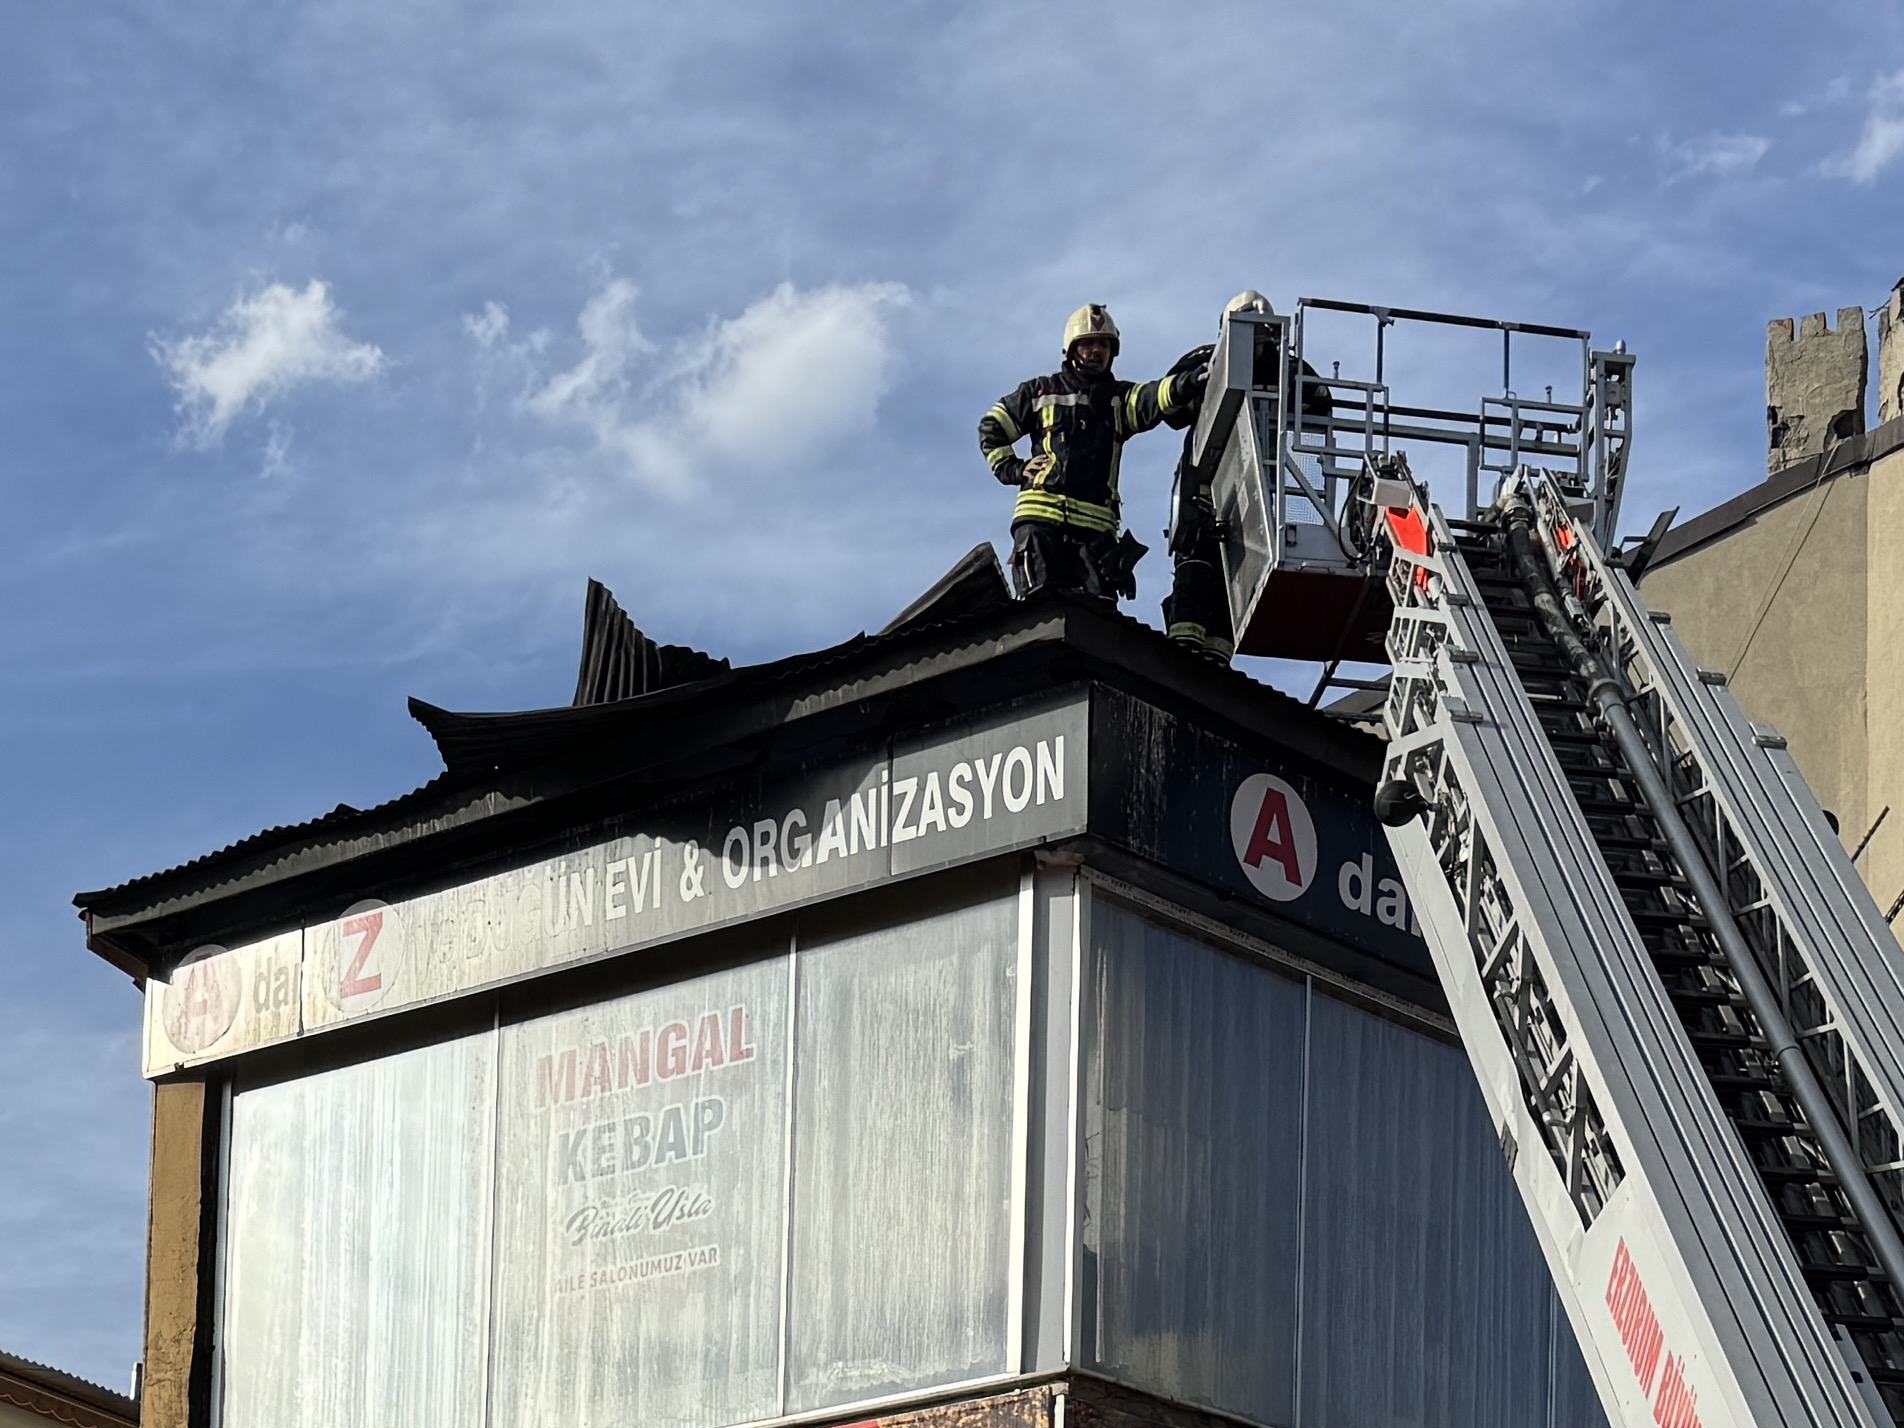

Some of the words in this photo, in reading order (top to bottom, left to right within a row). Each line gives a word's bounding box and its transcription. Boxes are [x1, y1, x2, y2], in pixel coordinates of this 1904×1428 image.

[339, 910, 384, 999] Z
[604, 836, 663, 921] EVİ
[679, 841, 706, 903] &
[722, 735, 1066, 891] ORGANİZASYON
[1243, 786, 1303, 888] A
[536, 1006, 756, 1111] MANGAL
[558, 1097, 725, 1187] KEBAP
[650, 1187, 713, 1231] Usta
[589, 1251, 684, 1289] SALONUMUZ
[687, 1247, 720, 1269] VAR
